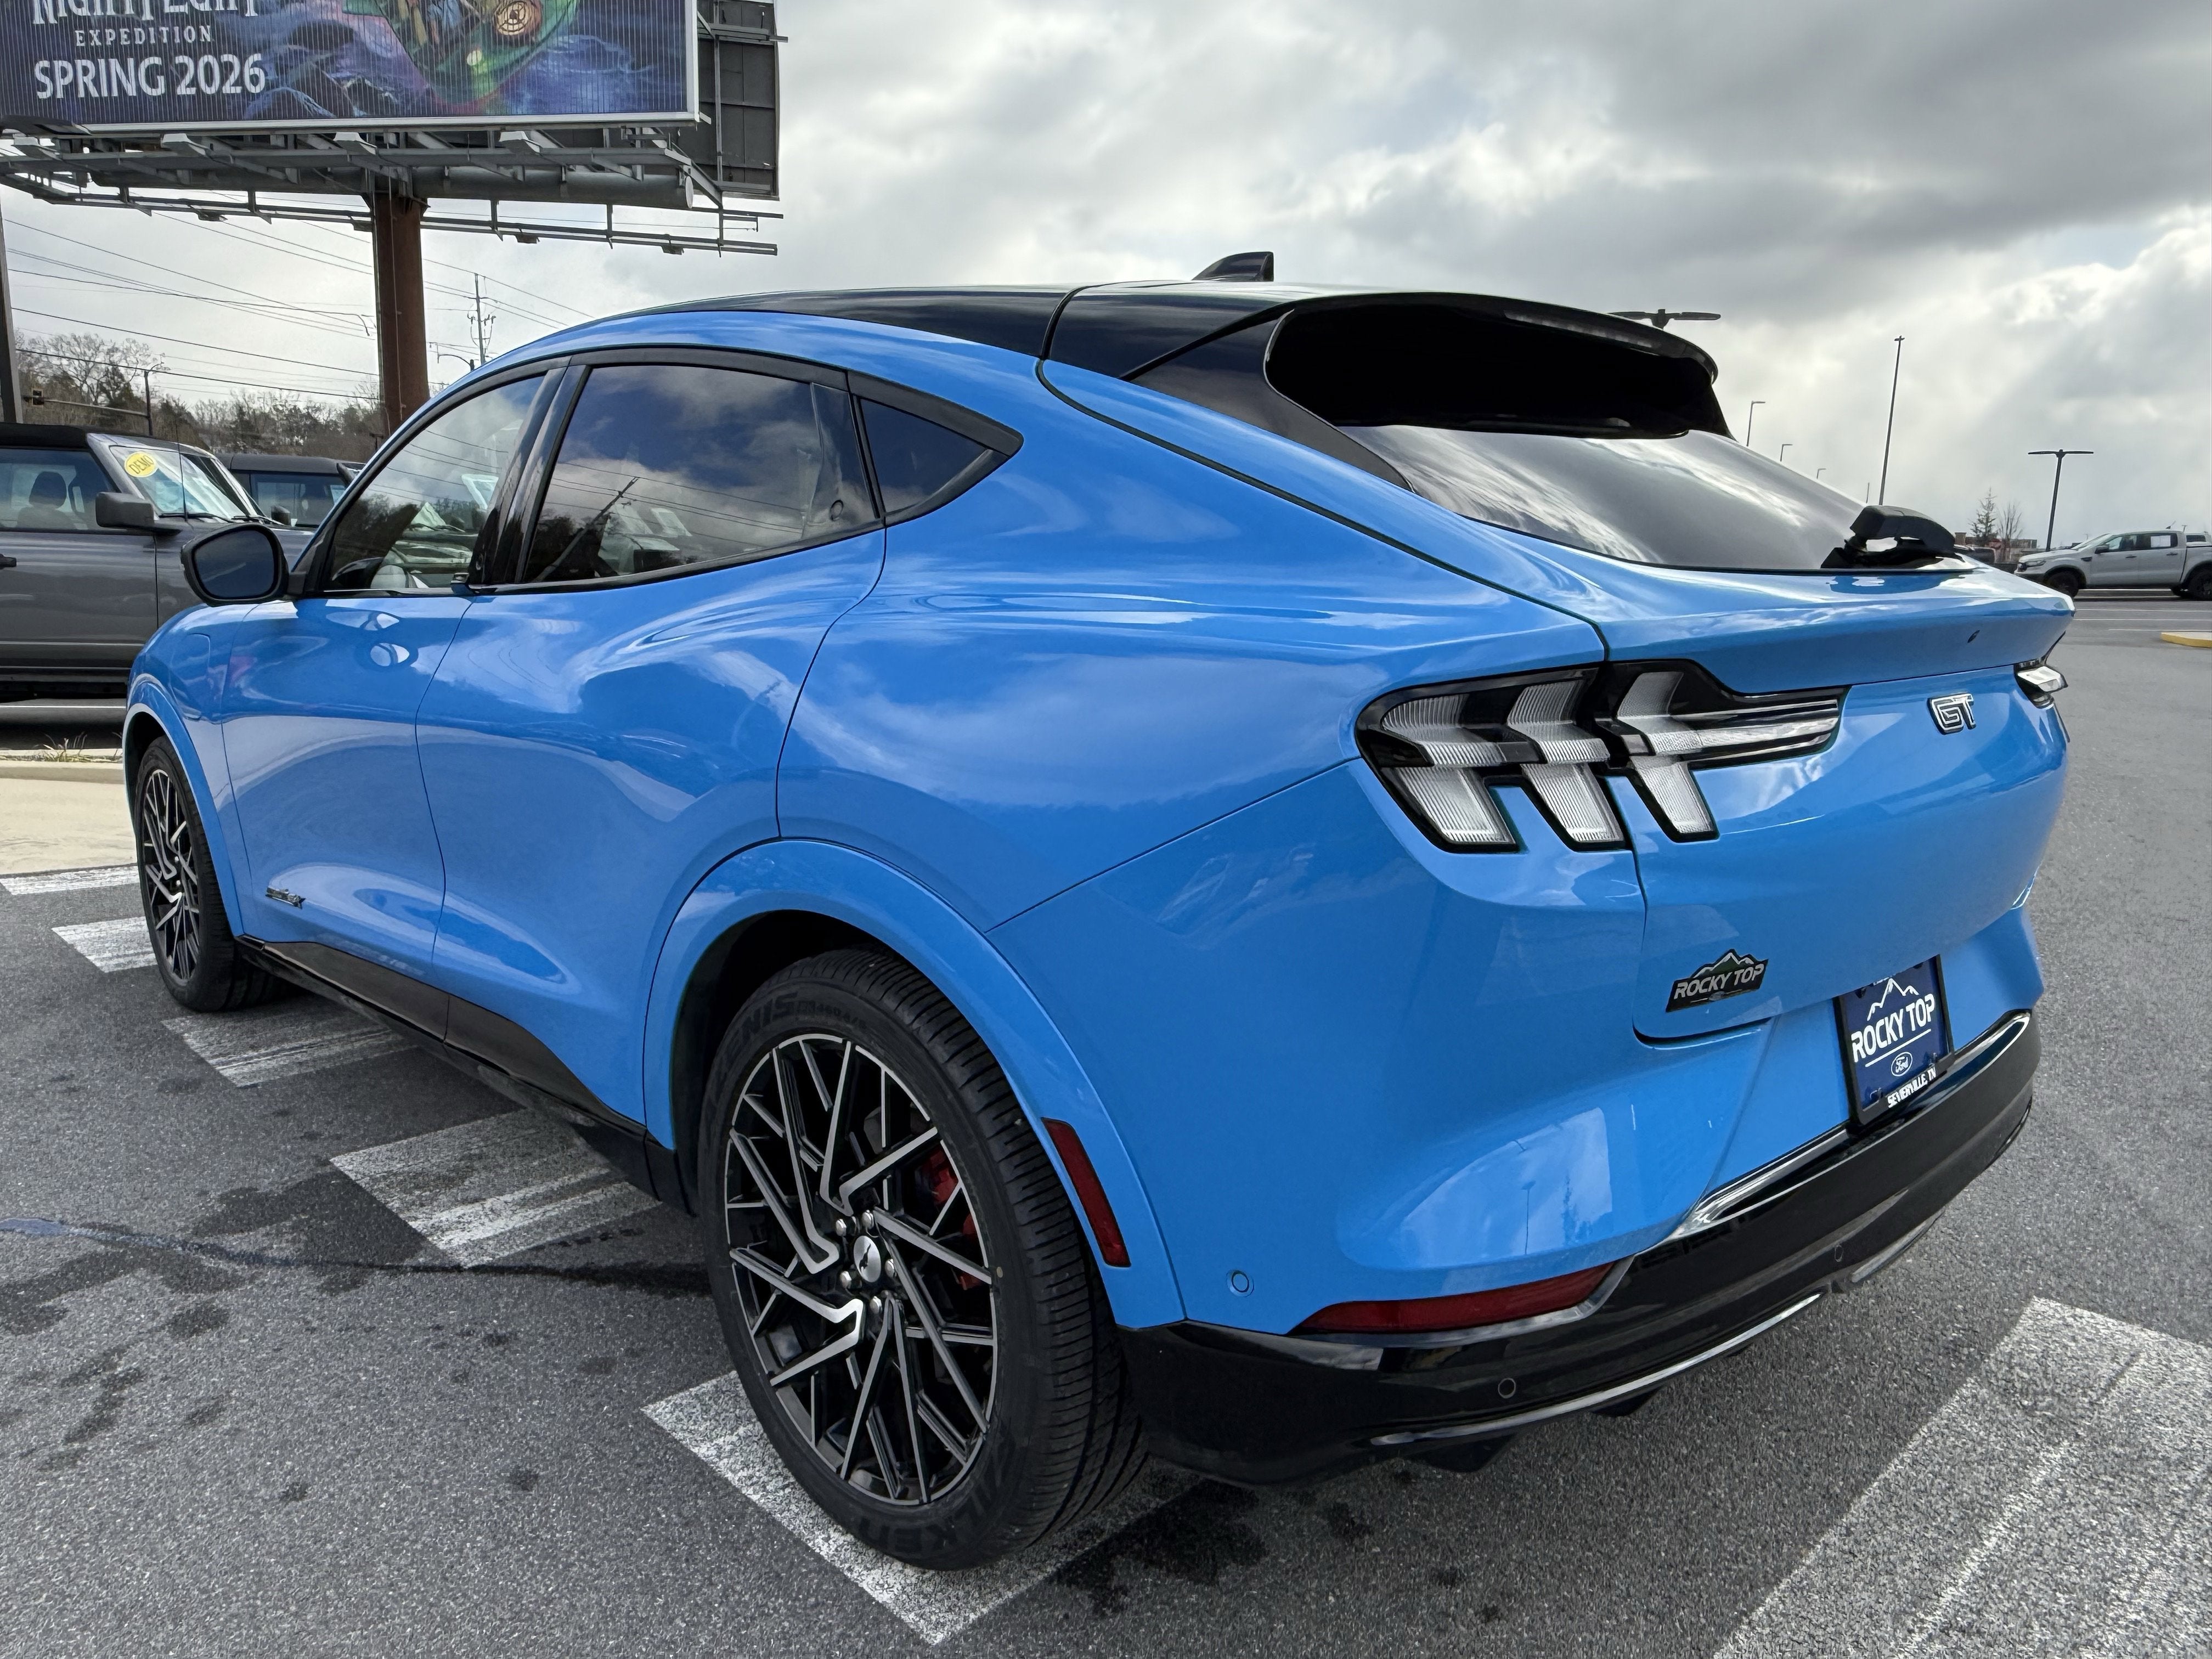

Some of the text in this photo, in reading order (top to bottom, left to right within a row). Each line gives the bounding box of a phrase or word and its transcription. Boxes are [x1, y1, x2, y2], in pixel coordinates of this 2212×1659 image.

[75, 25, 211, 46] EXPEDITION
[34, 53, 266, 99] SPRING 2026
[128, 455, 154, 475] DEMO
[1927, 693, 1976, 735] GT
[1674, 972, 1733, 1000] ROCKY
[1734, 963, 1765, 986] TOP
[1851, 993, 1935, 1063] ROCKY TOP
